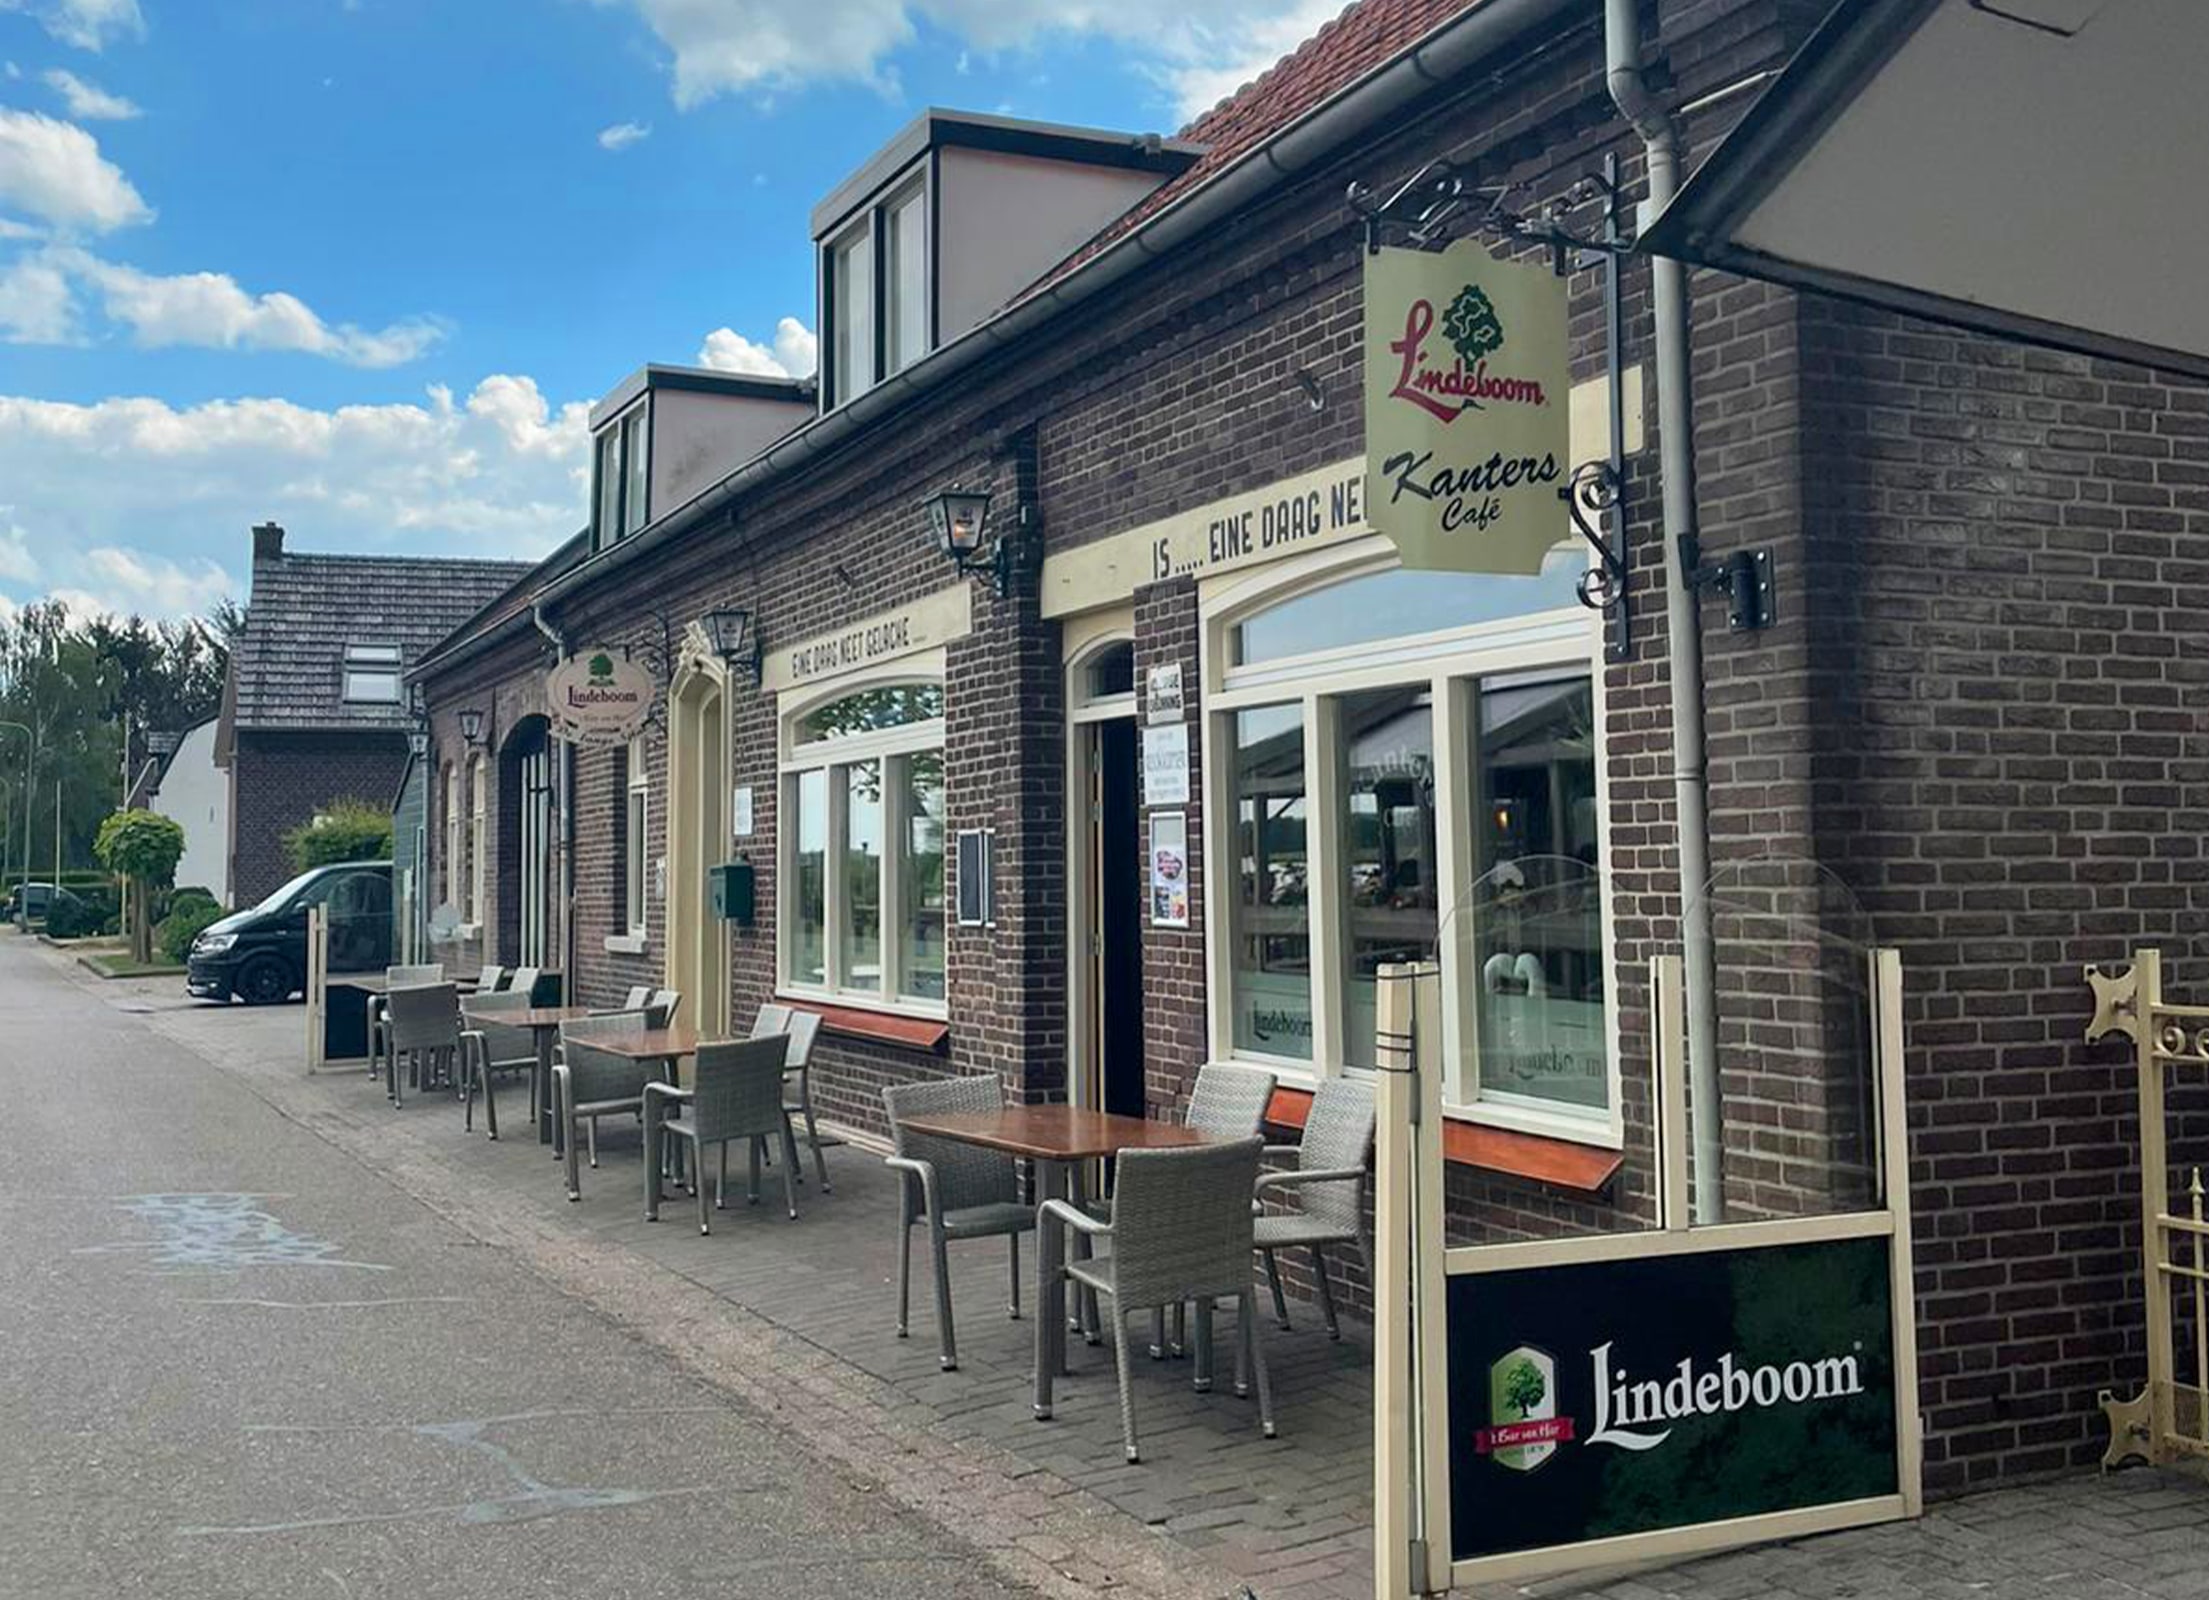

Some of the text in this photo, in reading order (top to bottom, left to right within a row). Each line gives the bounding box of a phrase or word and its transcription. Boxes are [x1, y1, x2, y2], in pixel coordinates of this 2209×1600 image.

[1390, 299, 1547, 424] Lindeboom
[1382, 451, 1560, 503] Kanters
[1210, 511, 1254, 563] EINE
[1262, 490, 1321, 549] DAAG
[1331, 473, 1368, 530] NE
[1441, 497, 1502, 532] Café
[567, 685, 639, 709] Lindeboom
[1584, 1340, 1865, 1451] Lindeboom
